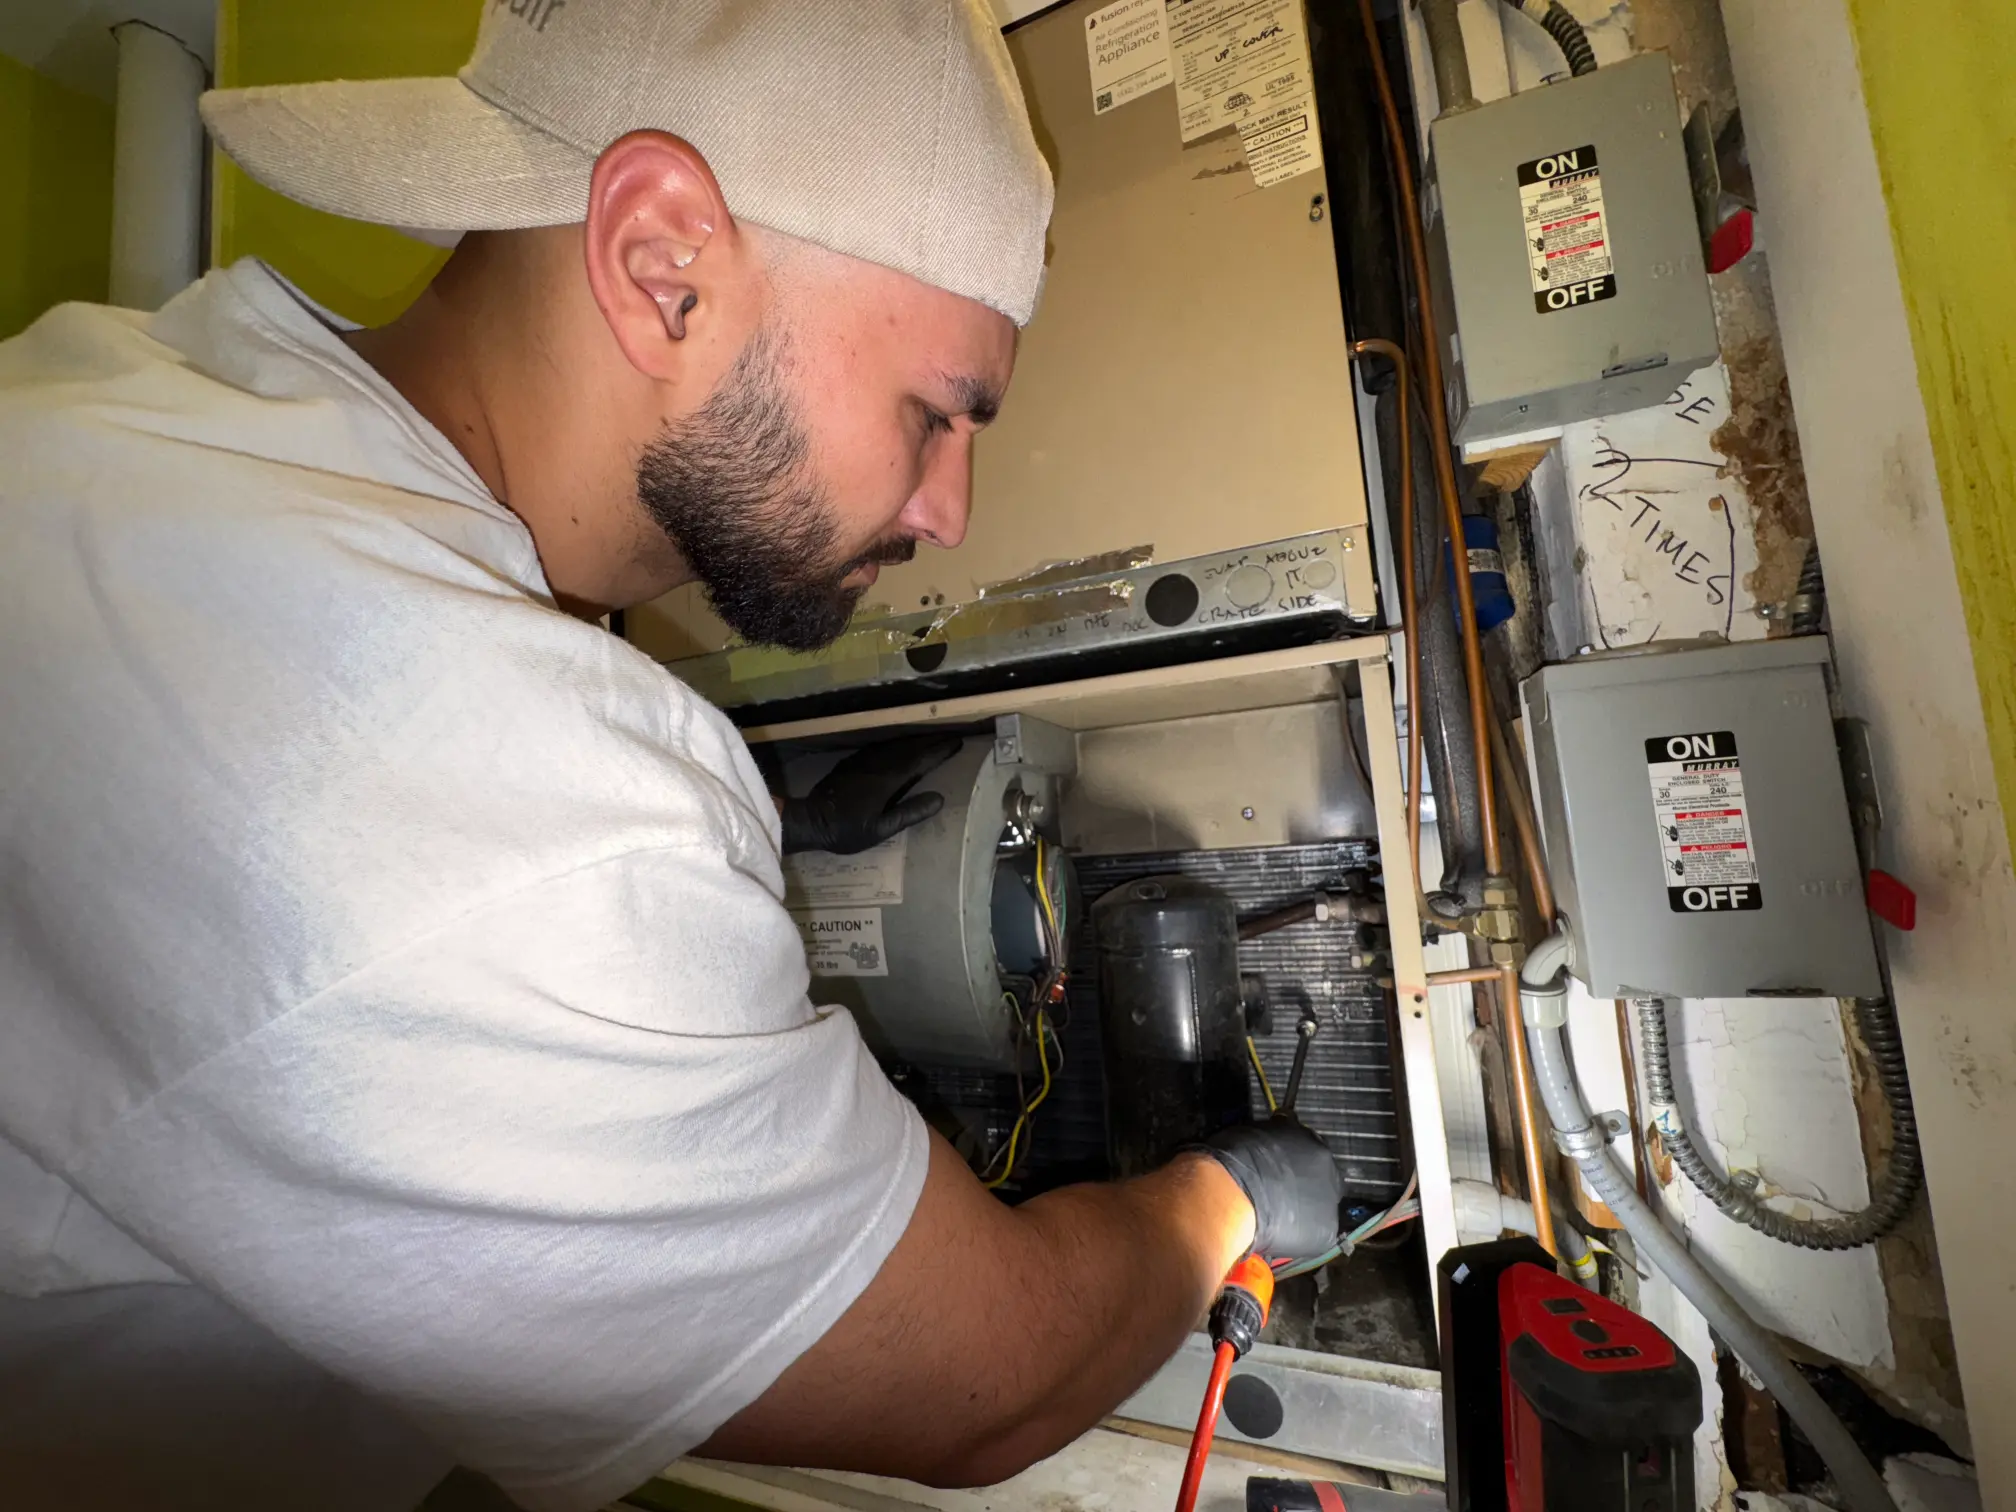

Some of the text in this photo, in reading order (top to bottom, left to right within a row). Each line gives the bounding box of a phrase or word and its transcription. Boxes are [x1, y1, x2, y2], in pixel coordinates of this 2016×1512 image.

[1101, 5, 1129, 23] fusion
[1095, 20, 1159, 54] Refrigeration
[1098, 31, 1160, 66] Appliance
[1215, 49, 1229, 62] UP
[1259, 115, 1275, 124] MAY
[1277, 101, 1308, 117] RESULT
[1253, 126, 1291, 146] CAUTION
[1536, 151, 1579, 179] ON
[1573, 195, 1588, 204] 240
[1528, 207, 1538, 215] 30
[1547, 278, 1605, 309] OFF
[1631, 496, 1731, 606] TIMES
[1666, 734, 1716, 759] ON
[1686, 761, 1737, 772] MURRAY
[1710, 786, 1727, 794] 240
[1682, 886, 1749, 911] OFF
[810, 920, 861, 932] CAUTION
